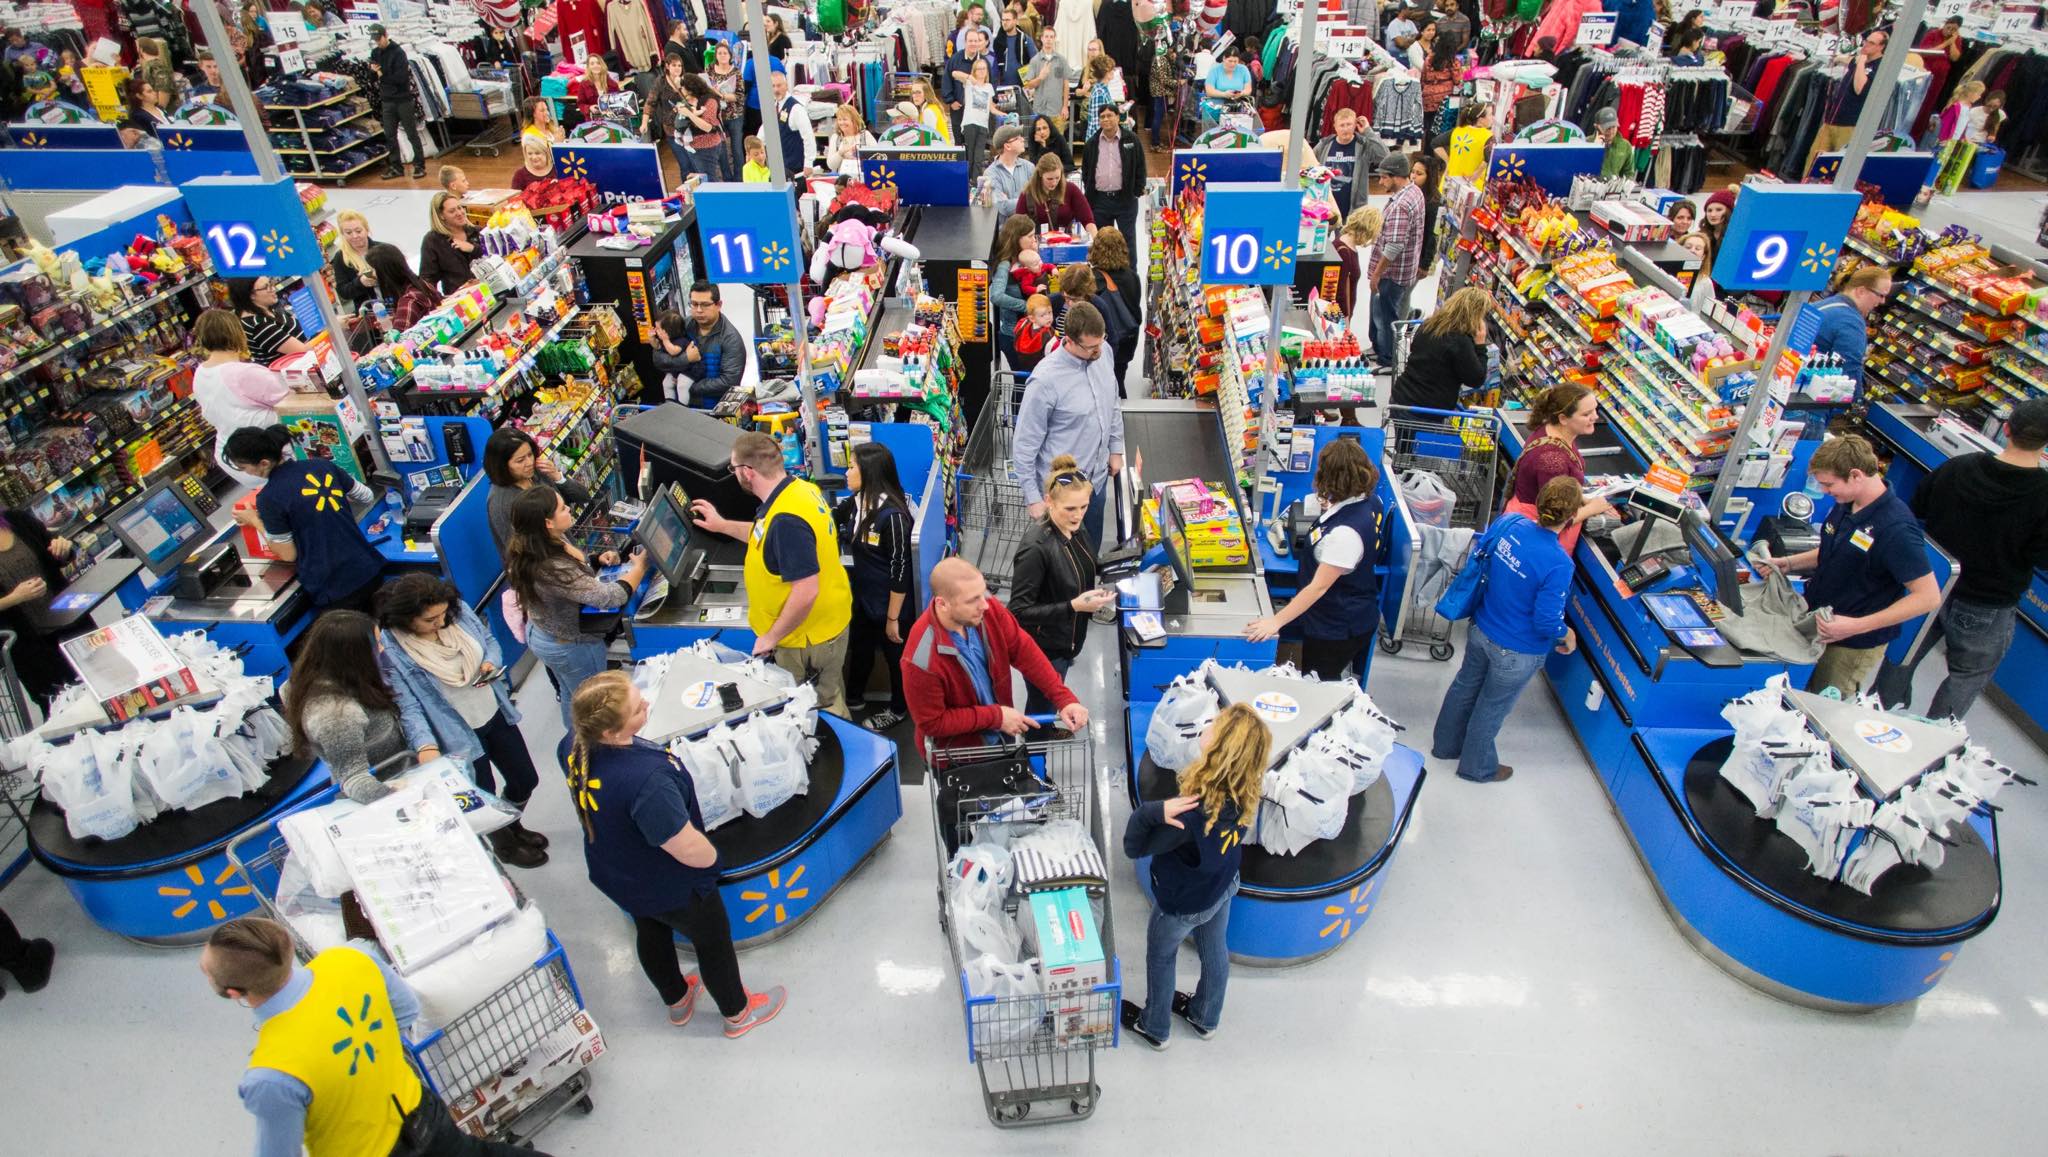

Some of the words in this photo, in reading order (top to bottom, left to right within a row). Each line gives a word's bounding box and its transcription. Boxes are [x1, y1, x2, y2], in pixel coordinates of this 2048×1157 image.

[899, 152, 958, 161] BENTONVILLE
[603, 191, 645, 206] Price
[207, 225, 267, 267] 12
[710, 234, 754, 273] 11
[1211, 234, 1259, 275] 10
[1751, 236, 1788, 279] 9
[589, 1033, 604, 1057] T-fal
